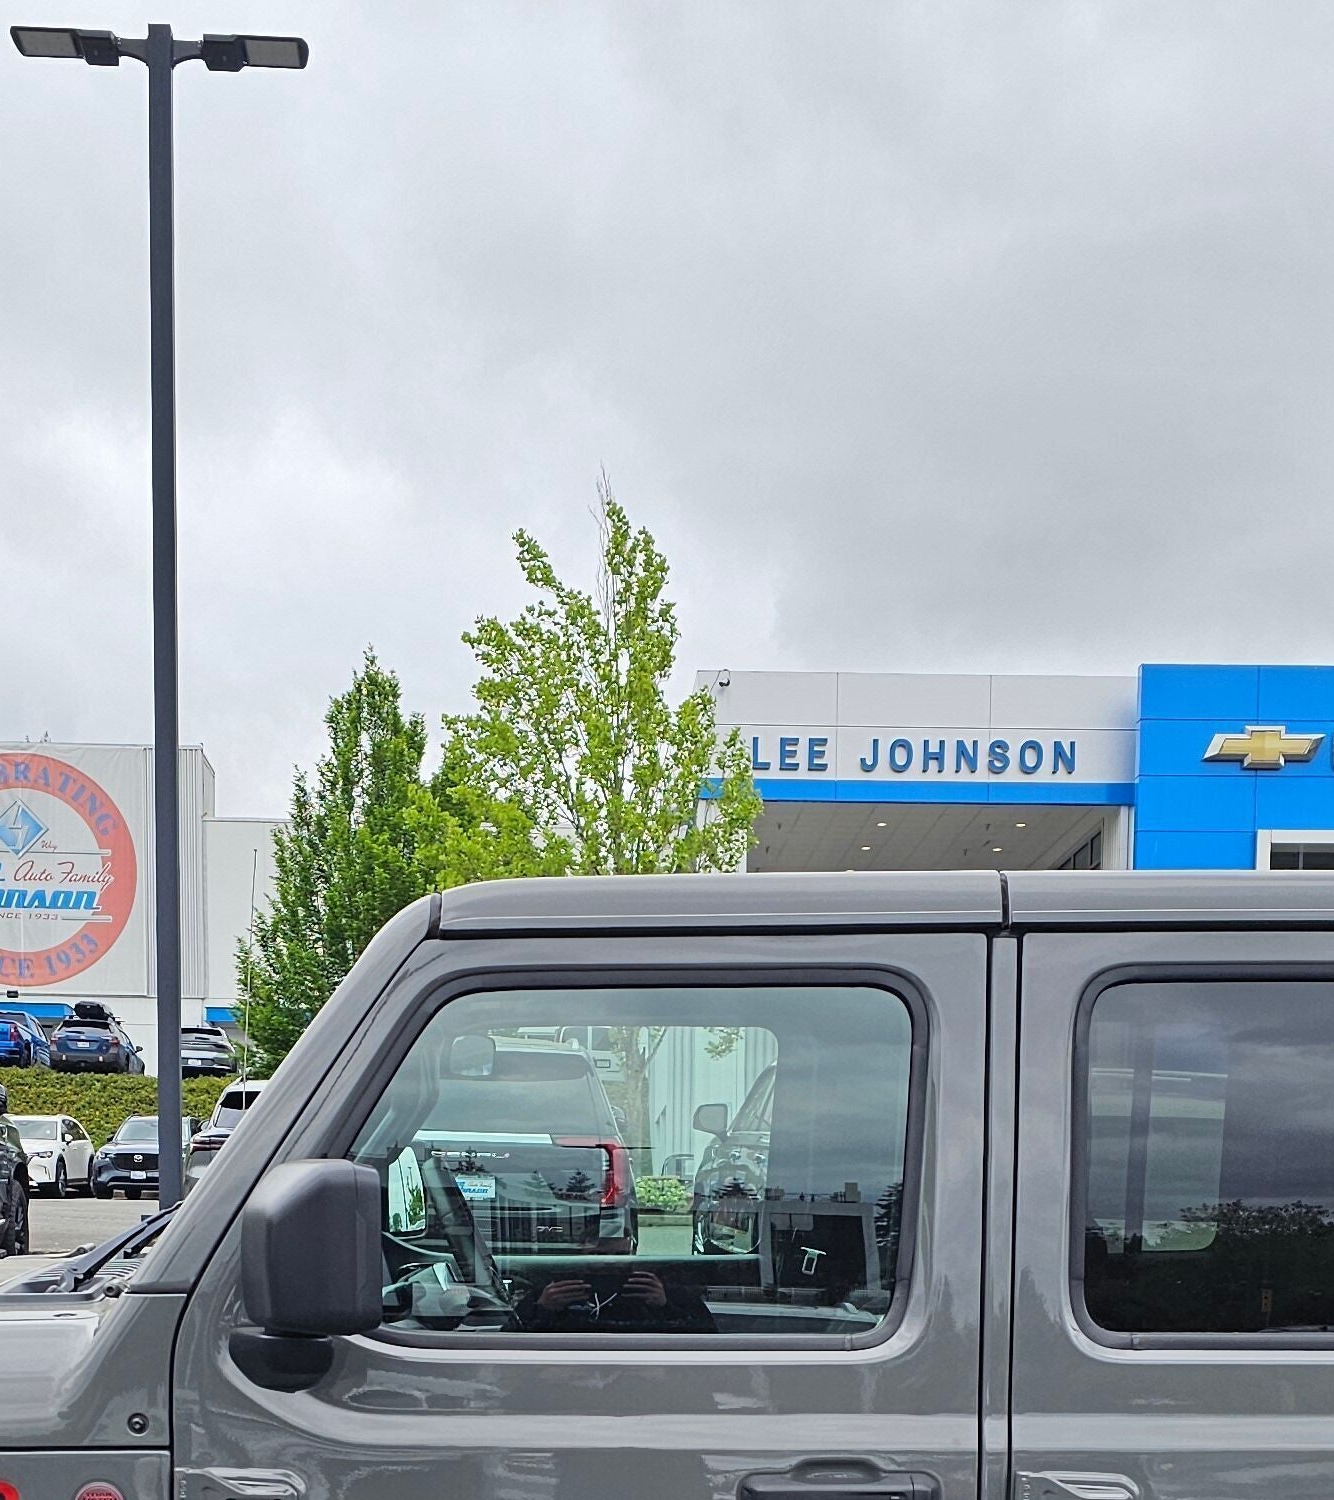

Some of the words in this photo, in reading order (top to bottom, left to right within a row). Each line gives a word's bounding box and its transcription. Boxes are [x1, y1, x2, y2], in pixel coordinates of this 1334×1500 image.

[751, 736, 829, 772] LEE
[860, 738, 1076, 775] JOHNSON
[14, 860, 54, 882] Auto
[57, 861, 115, 892] Family
[28, 912, 59, 921] 1933
[43, 932, 99, 976] 1933
